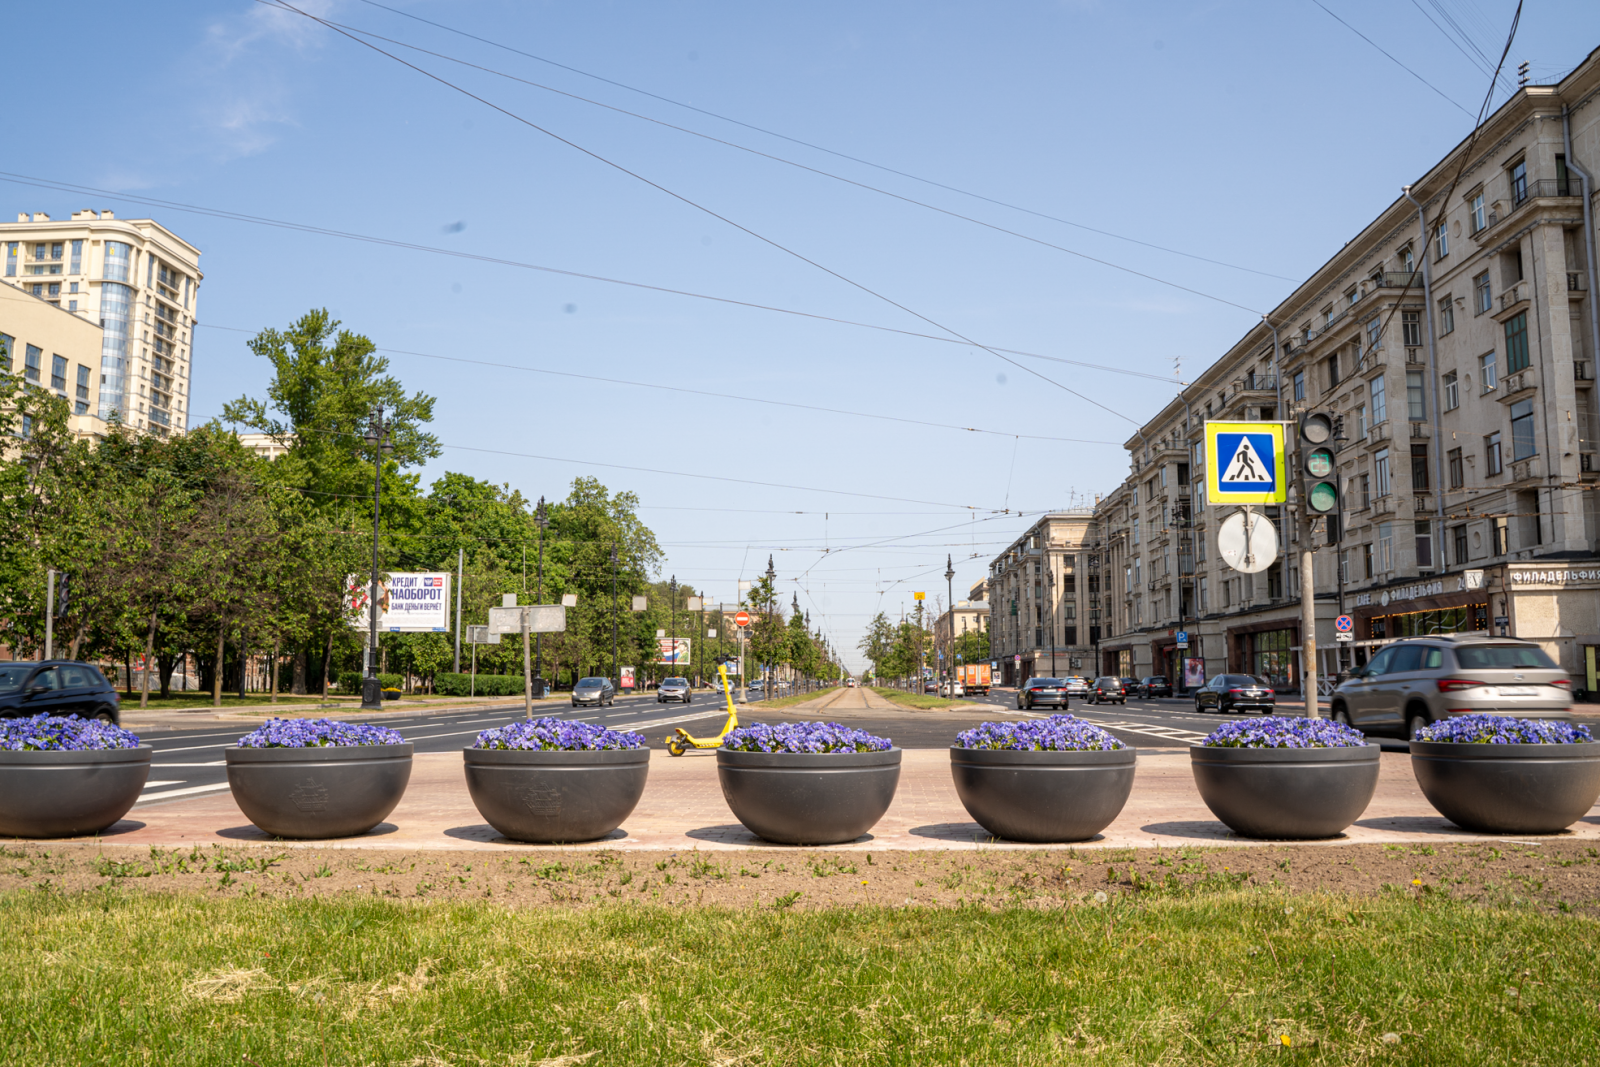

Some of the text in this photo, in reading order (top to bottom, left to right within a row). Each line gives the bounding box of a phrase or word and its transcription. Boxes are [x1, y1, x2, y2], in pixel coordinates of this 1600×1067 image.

[1311, 454, 1329, 472] 23
[392, 577, 418, 588] КРЕДИТ
[392, 588, 442, 600] НАОБОРОТ
[1356, 593, 1371, 606] CAFE
[1390, 581, 1443, 601] ФИЛАДЕЛЬФИЯ
[391, 602, 404, 610] БАНК
[404, 602, 423, 611] ДЕНЬГИ
